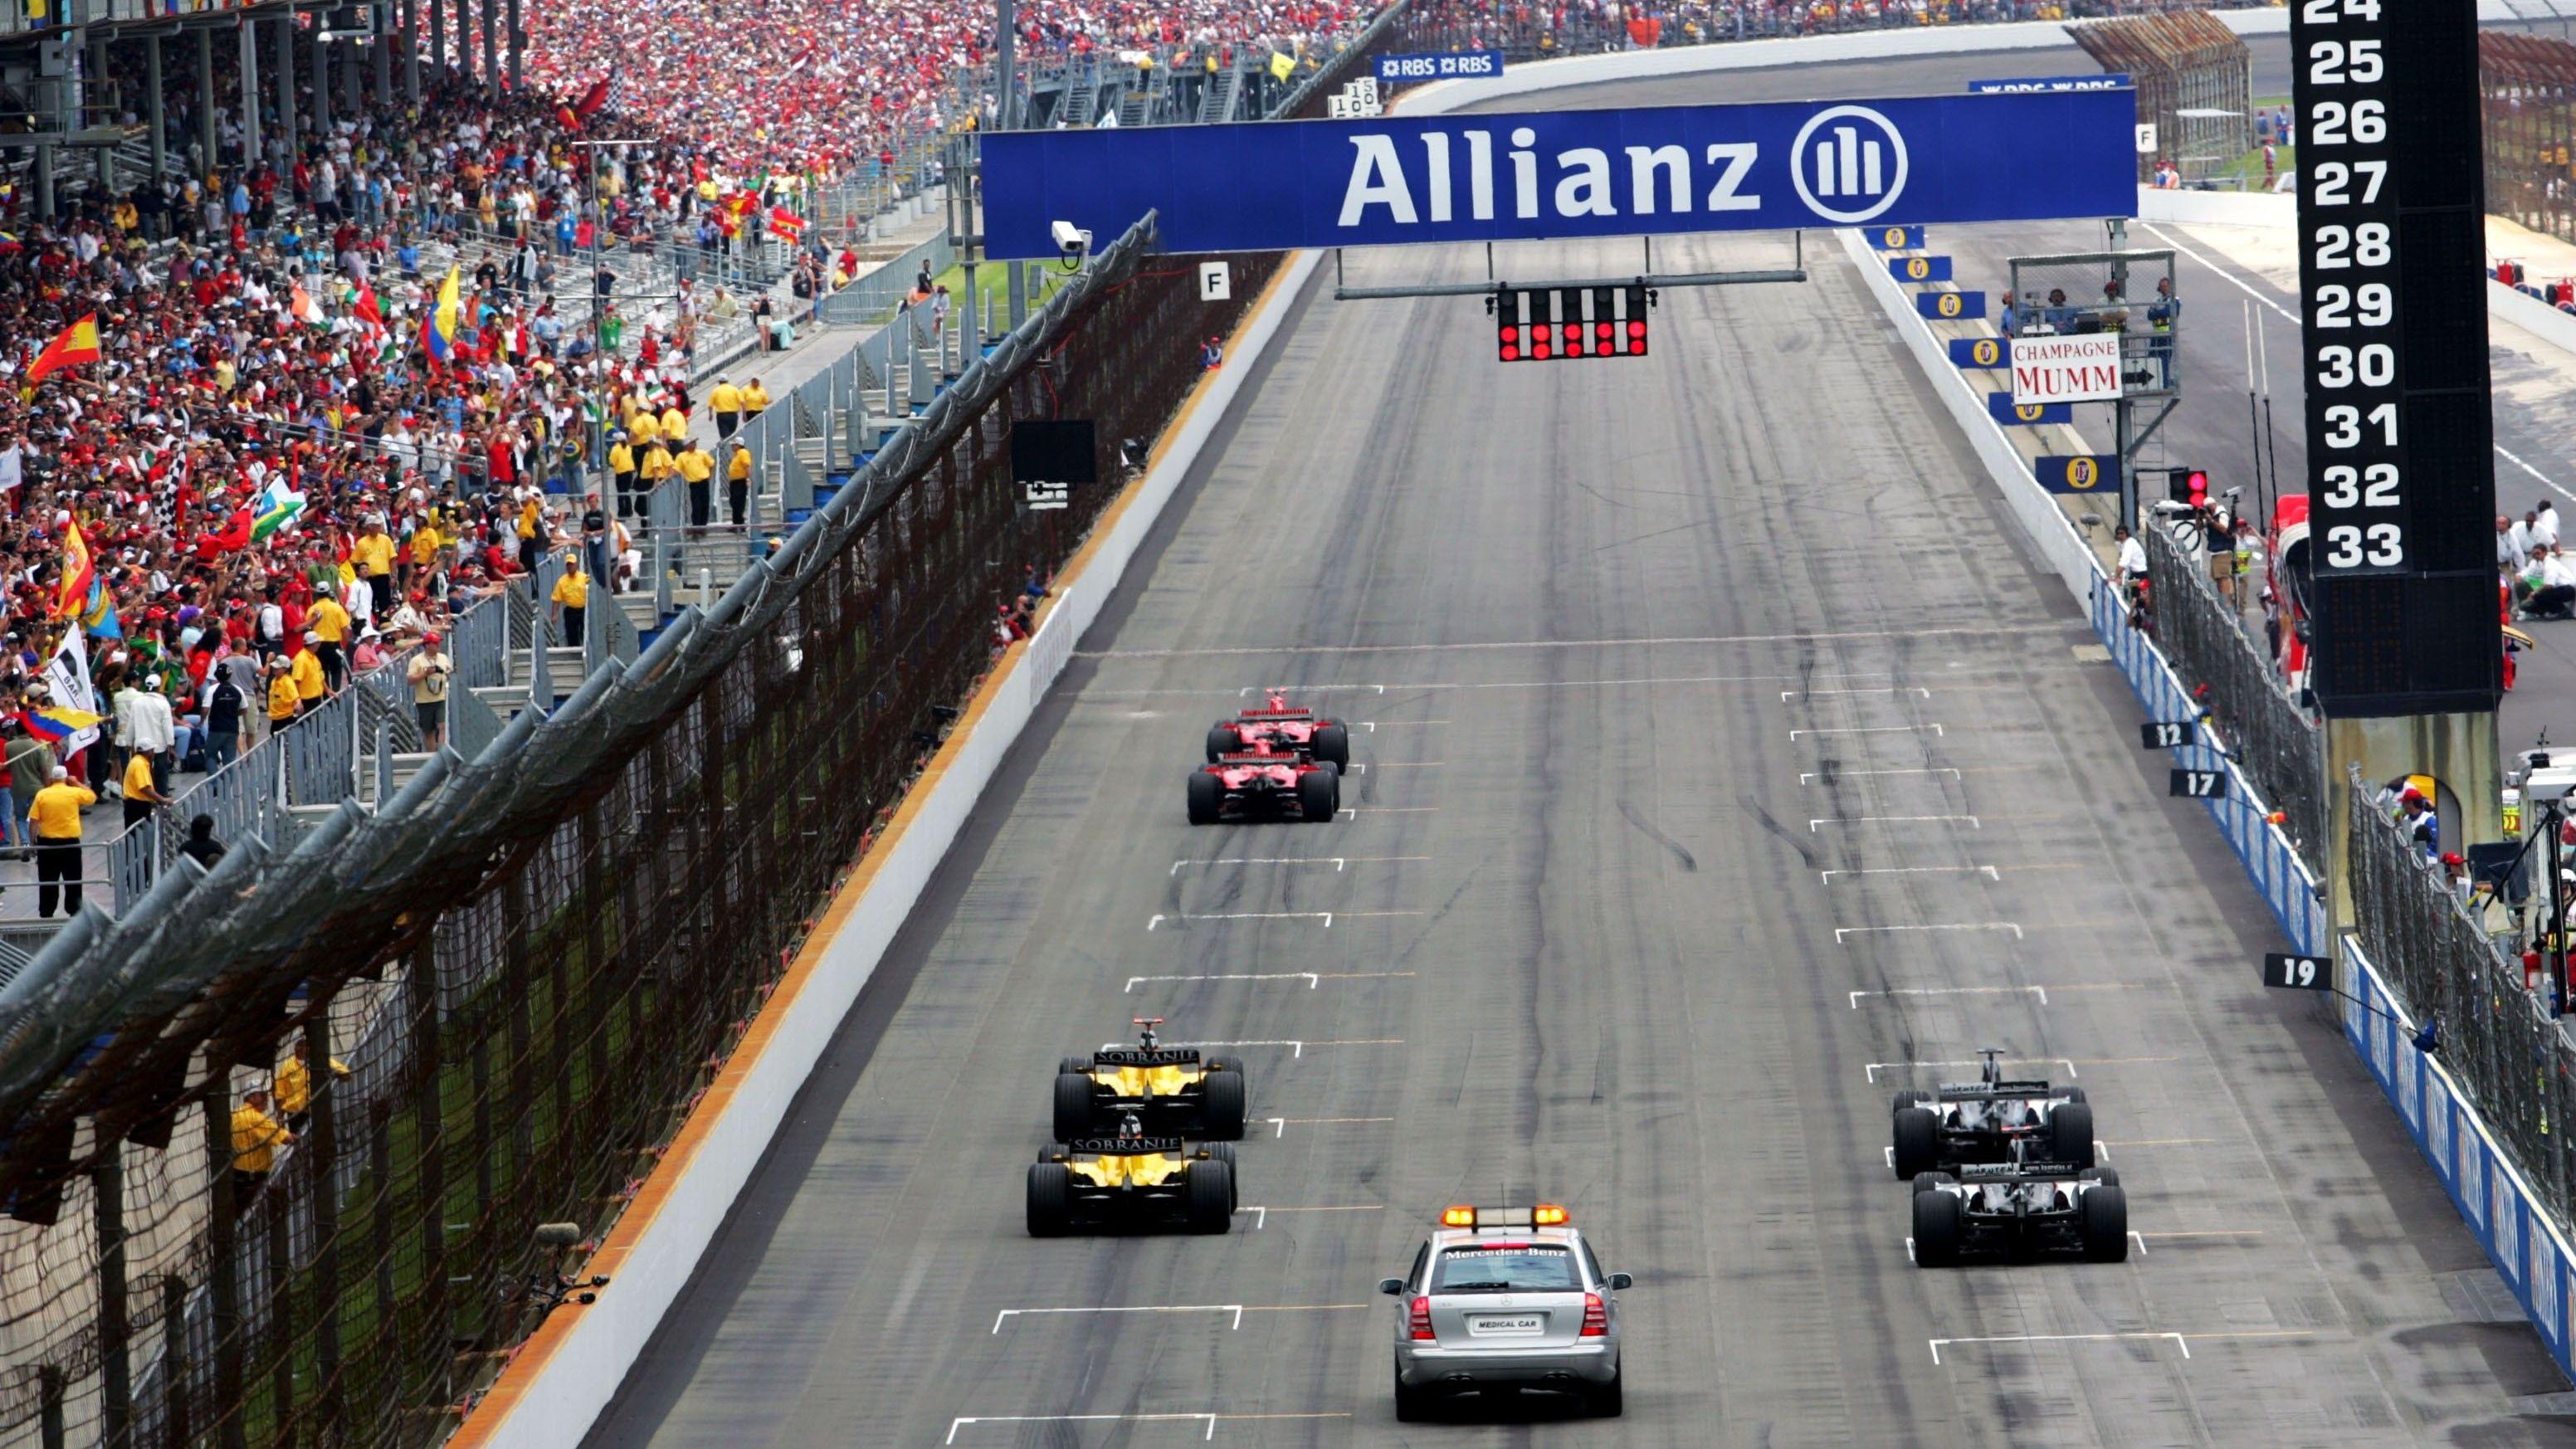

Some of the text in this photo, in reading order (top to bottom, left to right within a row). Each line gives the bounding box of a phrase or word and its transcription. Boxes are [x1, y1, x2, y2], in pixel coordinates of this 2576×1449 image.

[1402, 55, 1492, 76] RBS RBS
[2310, 40, 2383, 85] 25
[2141, 131, 2149, 144] F
[2313, 100, 2387, 145] 26
[1337, 126, 1762, 227] Allianz
[2315, 161, 2388, 206] 27
[2315, 222, 2391, 269] 28
[1208, 273, 1222, 293] F
[2315, 284, 2393, 329] 29
[2015, 340, 2116, 361] CHAMPAGNE
[2318, 344, 2394, 388] 30
[2017, 365, 2116, 397] MUMM
[2325, 403, 2398, 449] 31
[2324, 464, 2400, 509] 32
[2327, 524, 2403, 568] 33
[2156, 723, 2181, 746] 12
[2187, 773, 2215, 796] 17
[2285, 958, 2315, 986] 19
[1097, 1050, 1199, 1062] SOBRANIE
[1075, 1137, 1179, 1150] SOBRANIE
[1446, 1248, 1568, 1261] Mercedes-Benz
